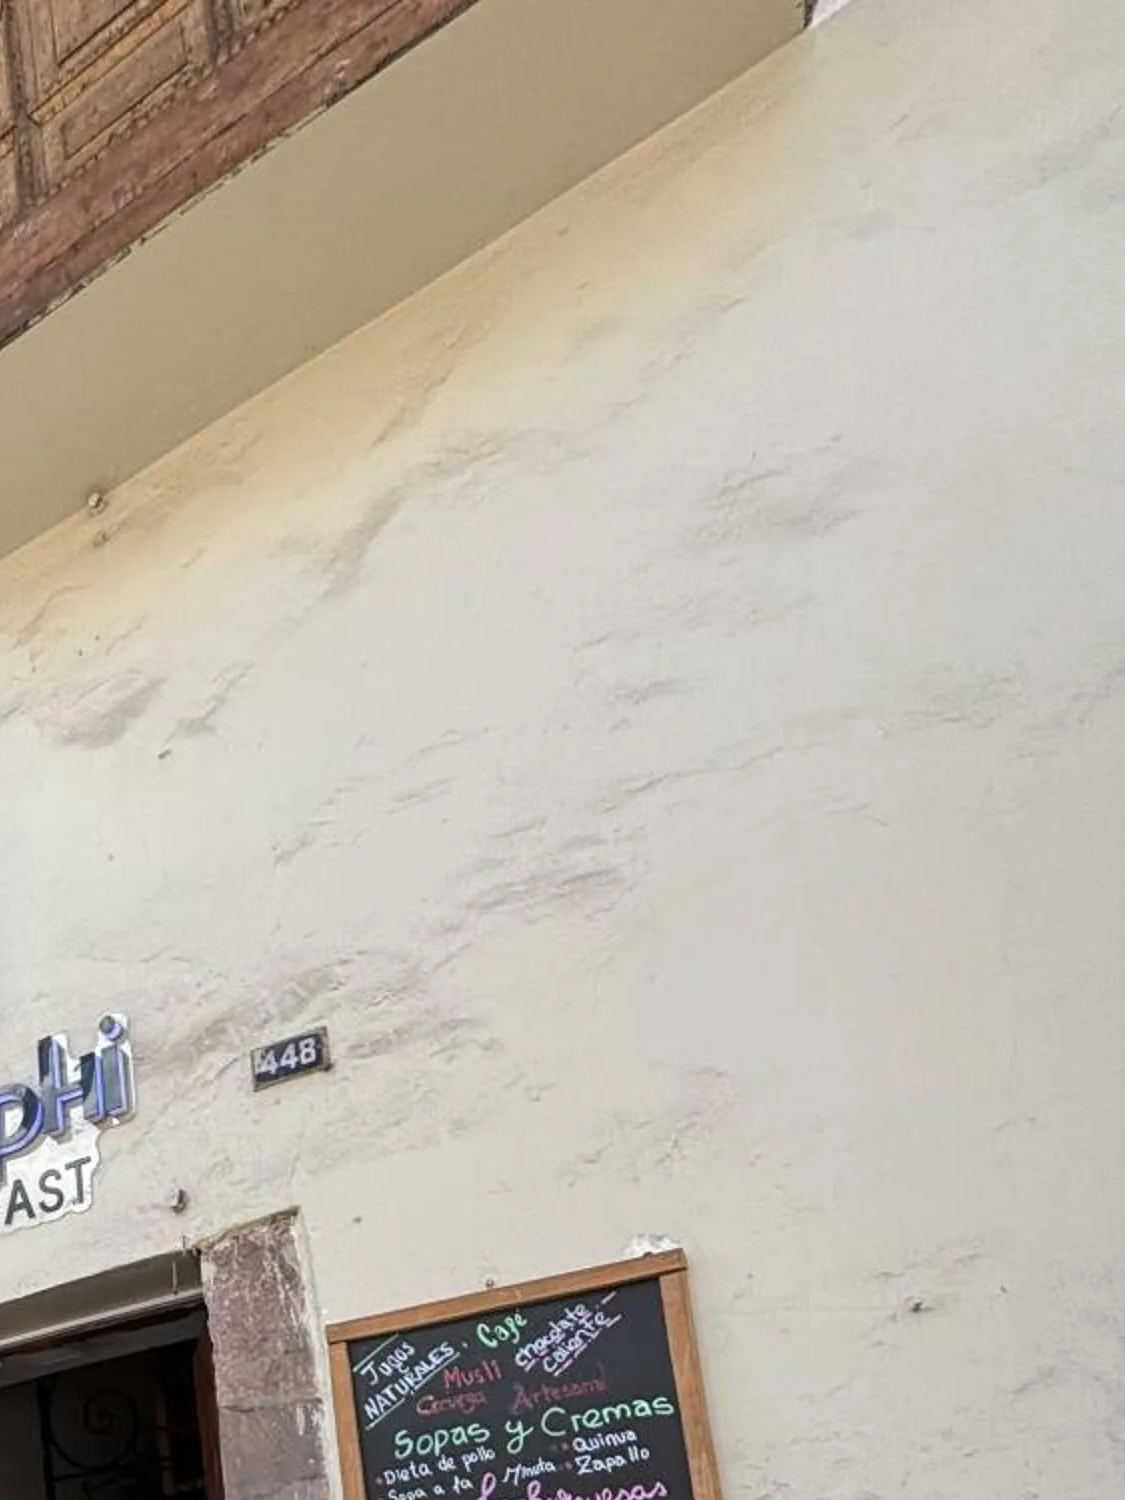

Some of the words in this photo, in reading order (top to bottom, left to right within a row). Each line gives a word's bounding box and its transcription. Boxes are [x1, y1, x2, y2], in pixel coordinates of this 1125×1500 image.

[255, 1037, 316, 1075] 448
[363, 1341, 455, 1420] NATURALES
[394, 1423, 491, 1460] Sopas
[505, 1420, 534, 1454] y
[541, 1395, 674, 1438] Cremas
[383, 1461, 433, 1485] Dieta
[438, 1454, 456, 1471] de
[462, 1448, 496, 1473] pollo
[433, 1484, 445, 1496] a
